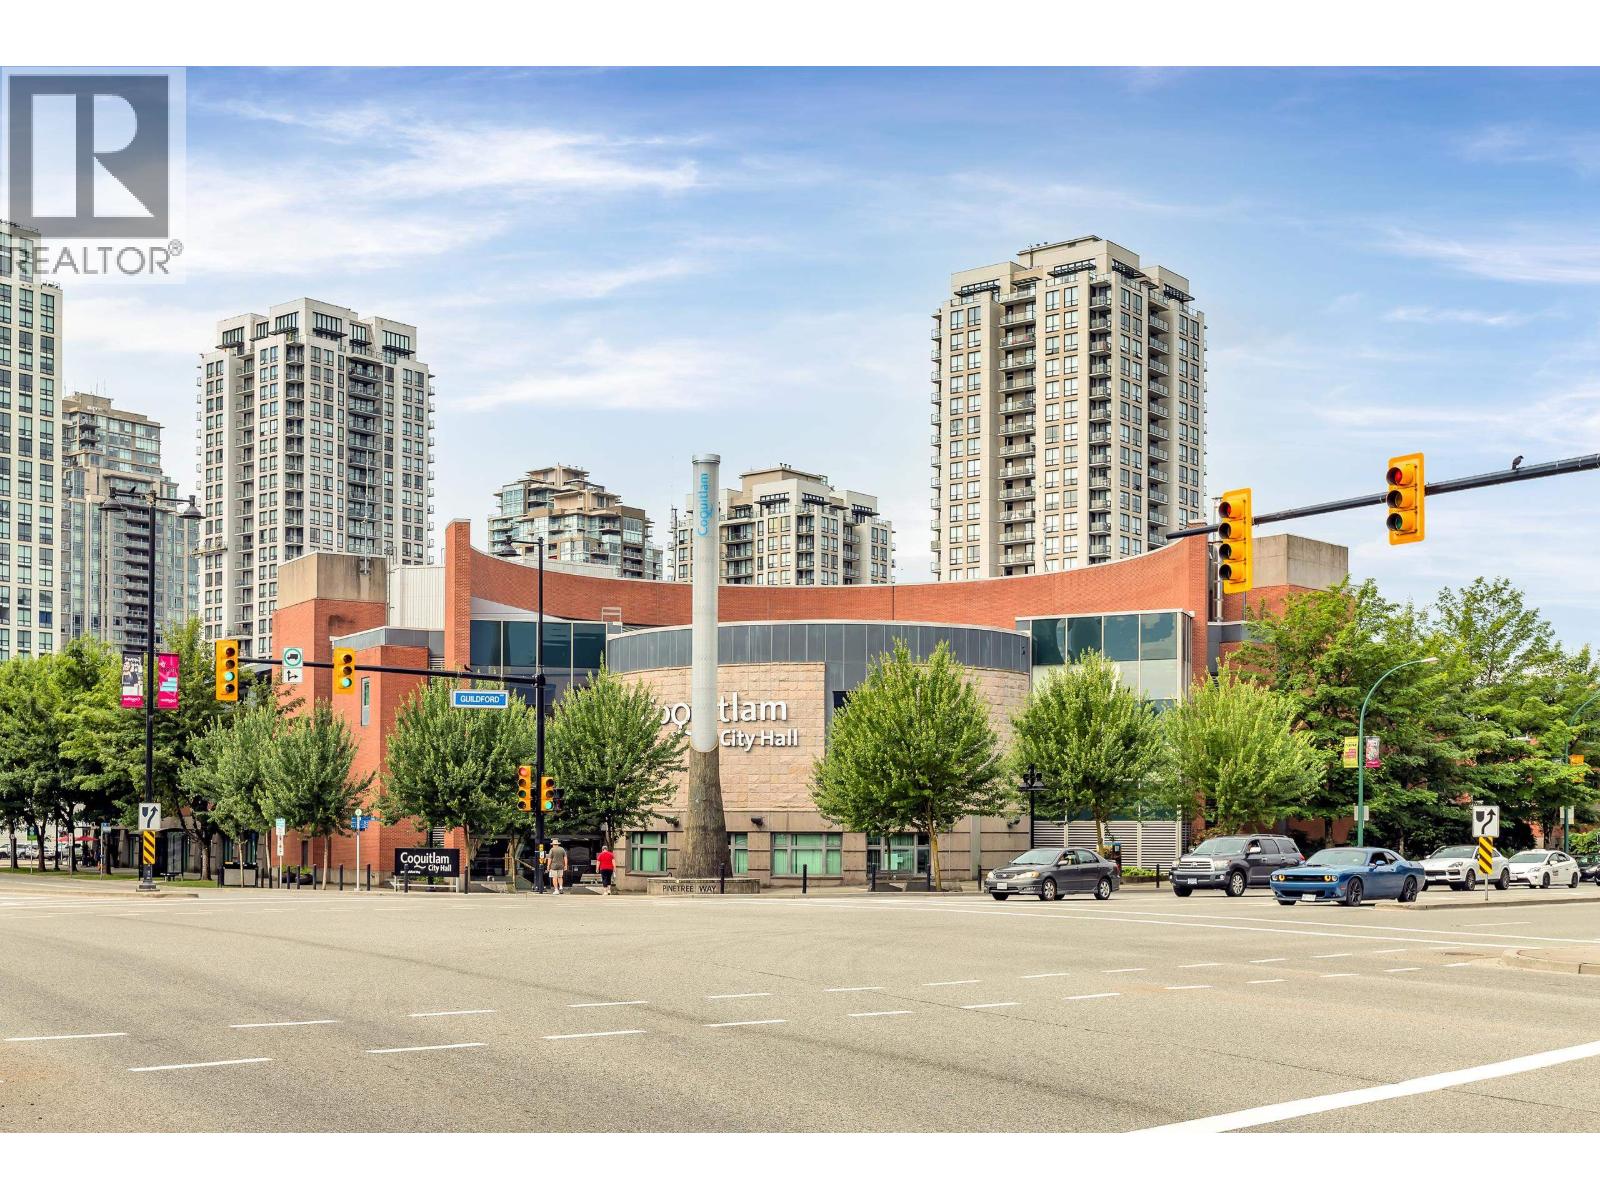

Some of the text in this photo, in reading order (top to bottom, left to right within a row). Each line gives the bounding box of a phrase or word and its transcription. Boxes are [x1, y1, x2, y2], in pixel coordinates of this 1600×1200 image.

[460, 695, 500, 703] GUILDFORD
[720, 728, 799, 752] City Hall
[428, 864, 440, 873] City
[440, 864, 452, 872] Hall
[662, 884, 717, 893] PINETREE WAY
